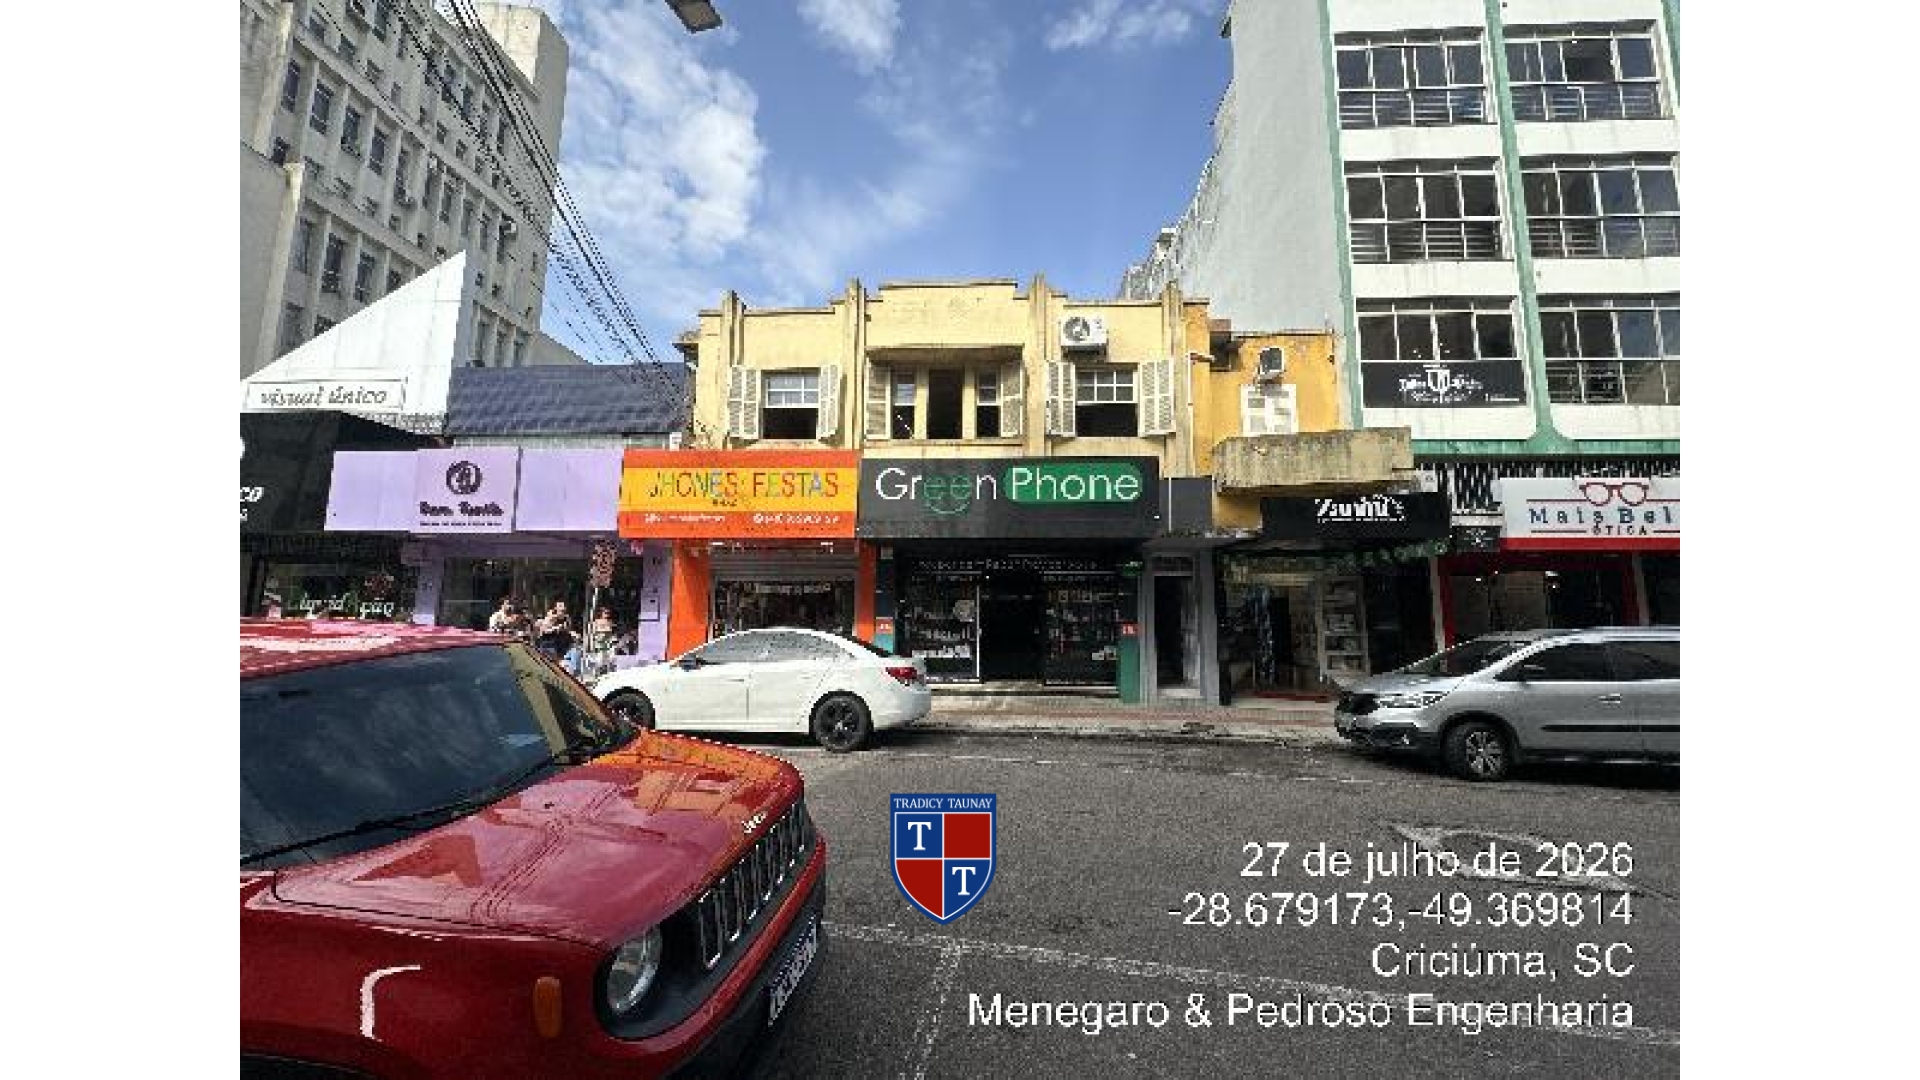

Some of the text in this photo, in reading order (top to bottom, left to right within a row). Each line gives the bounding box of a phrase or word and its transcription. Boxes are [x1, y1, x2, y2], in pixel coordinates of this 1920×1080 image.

[260, 385, 387, 406] visual único
[649, 472, 839, 498] JHONES FESTAS
[875, 467, 1140, 501] Green Phone
[1528, 507, 1604, 524] Mais
